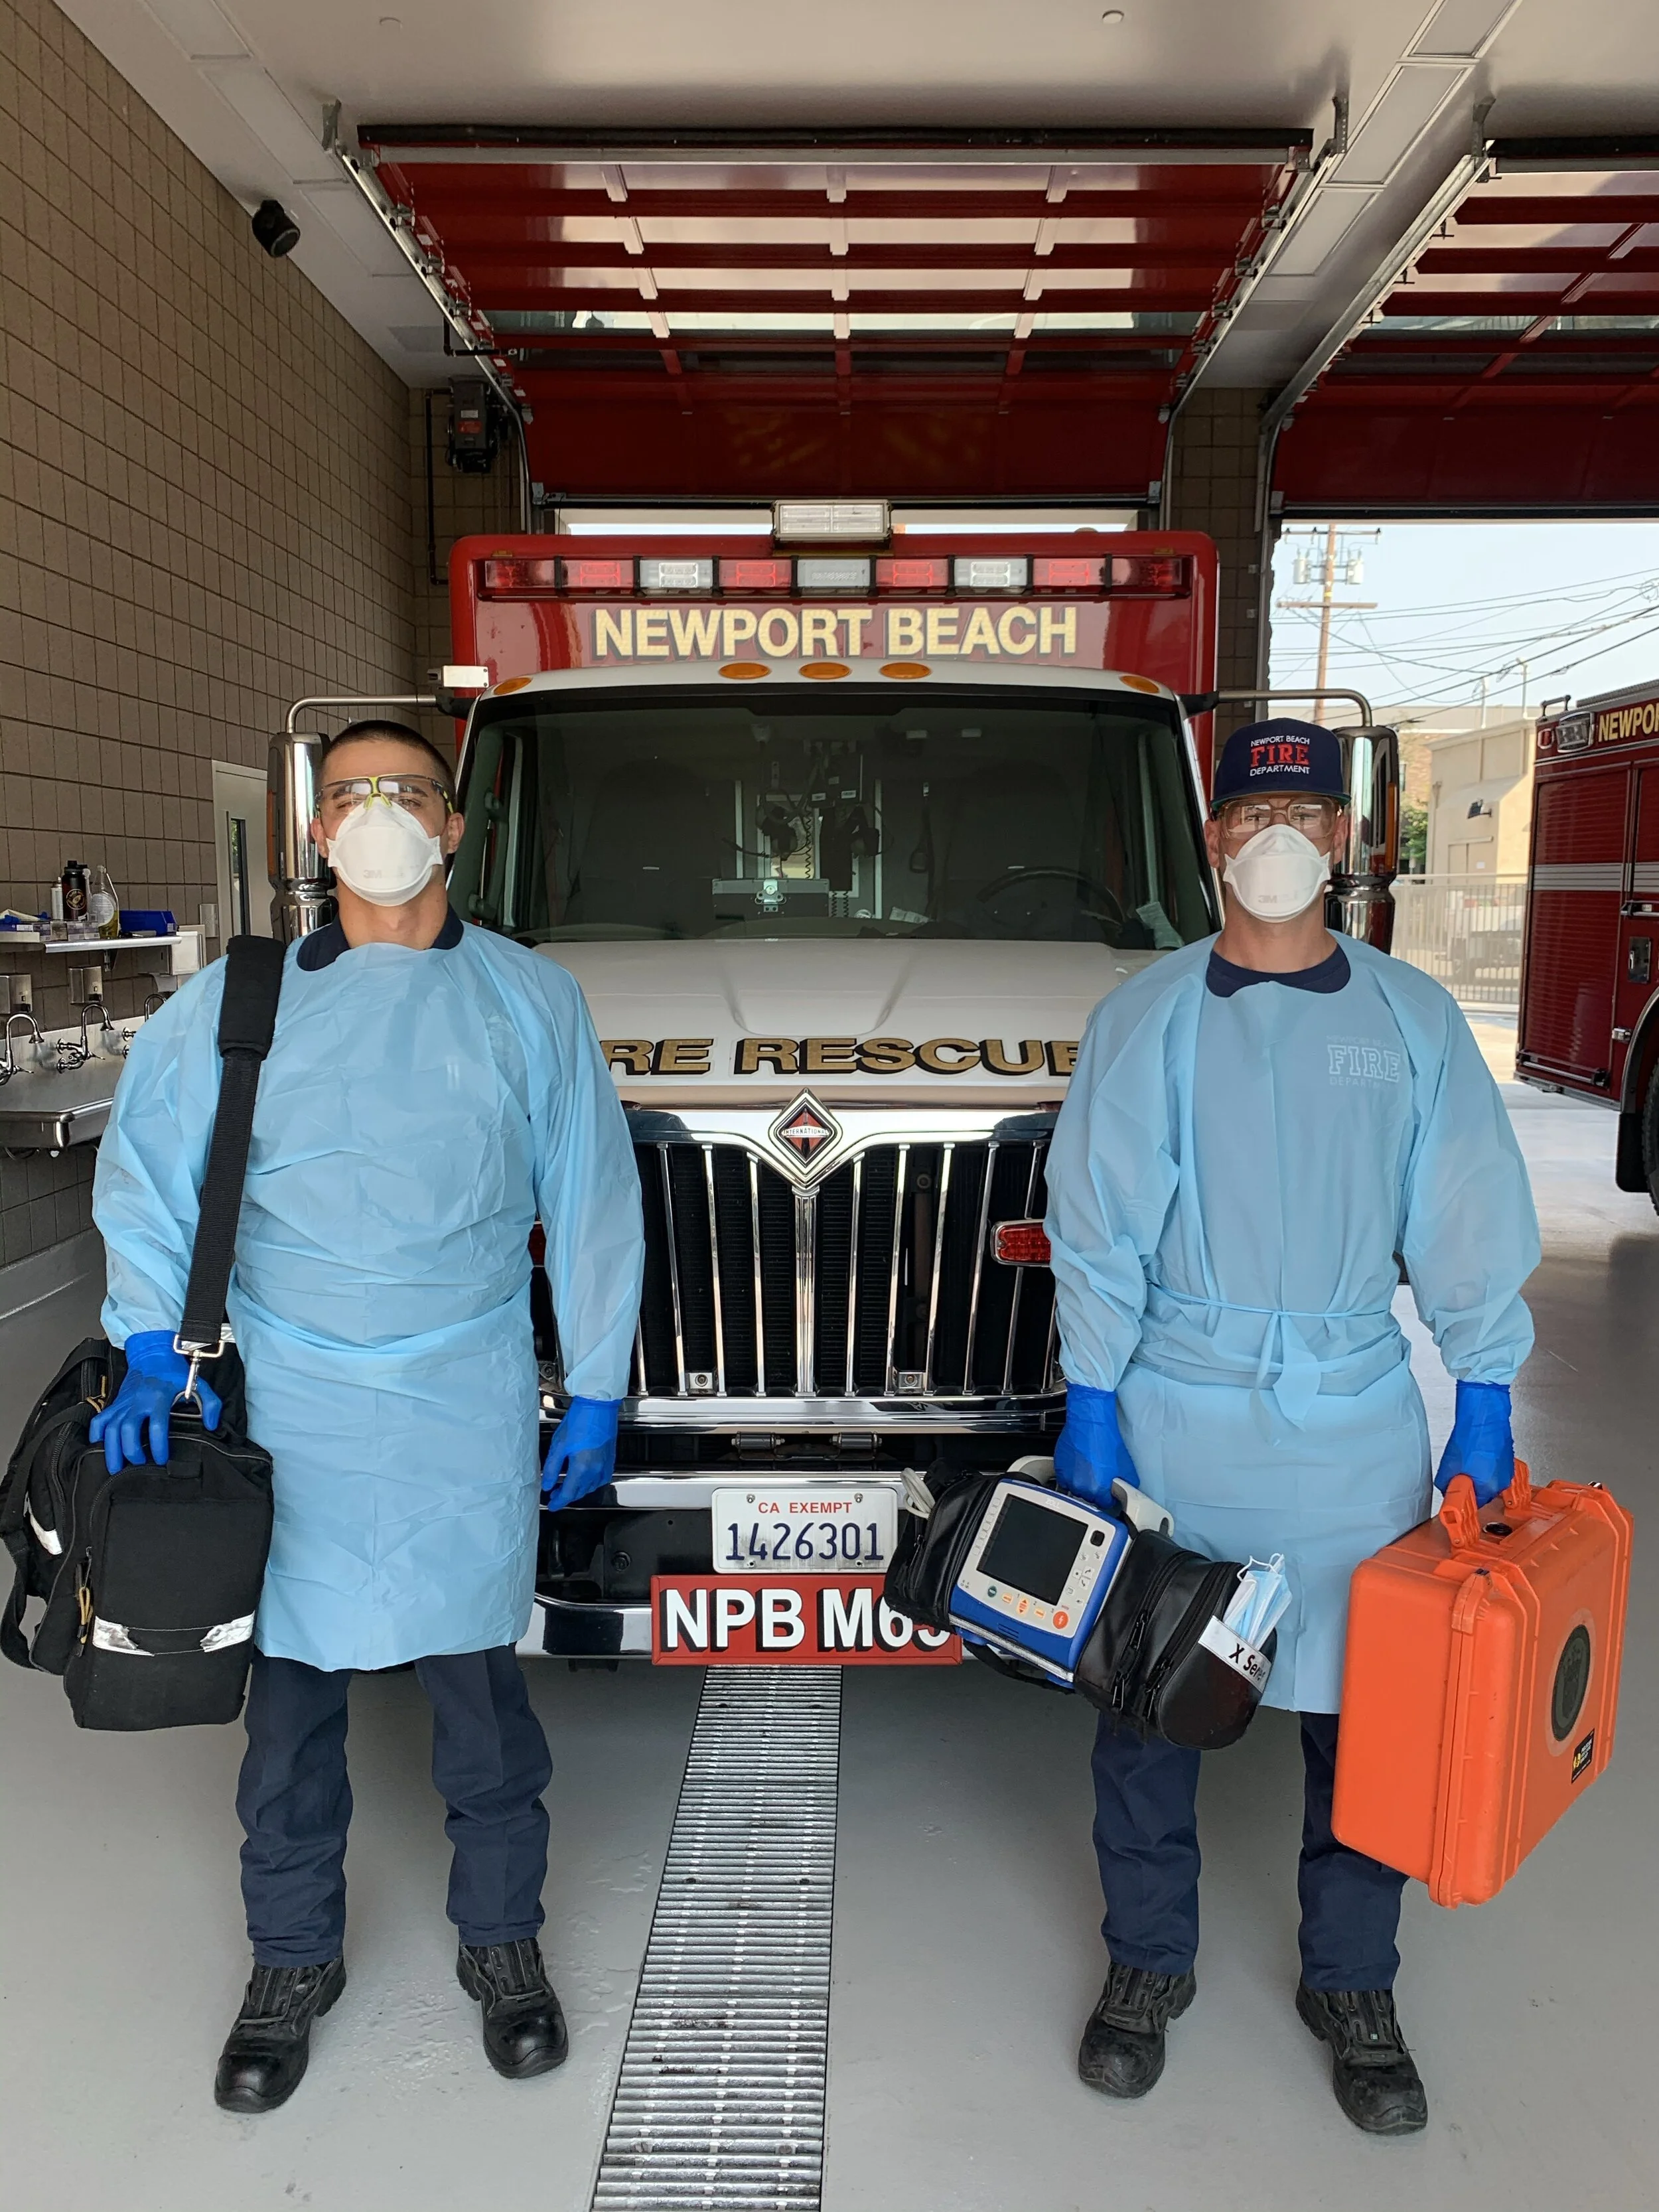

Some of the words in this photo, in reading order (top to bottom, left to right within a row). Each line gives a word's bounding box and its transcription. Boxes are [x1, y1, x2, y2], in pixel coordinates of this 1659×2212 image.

[594, 607, 873, 658] NEWPORT
[887, 606, 1076, 656] BEACH
[1250, 735, 1285, 747] NEWPORT
[1285, 735, 1311, 745] BEACH
[1250, 743, 1310, 768] FIRE
[1249, 764, 1311, 777] DEPARTMENT
[599, 1039, 715, 1076] RE
[733, 1037, 1080, 1076] RESCUE
[1327, 1043, 1401, 1083] FIRE
[758, 1502, 780, 1514] CA
[789, 1502, 853, 1514] EXEMPT
[725, 1522, 884, 1561] 1426301
[665, 1588, 806, 1649] NPB
[1228, 1643, 1245, 1664] X
